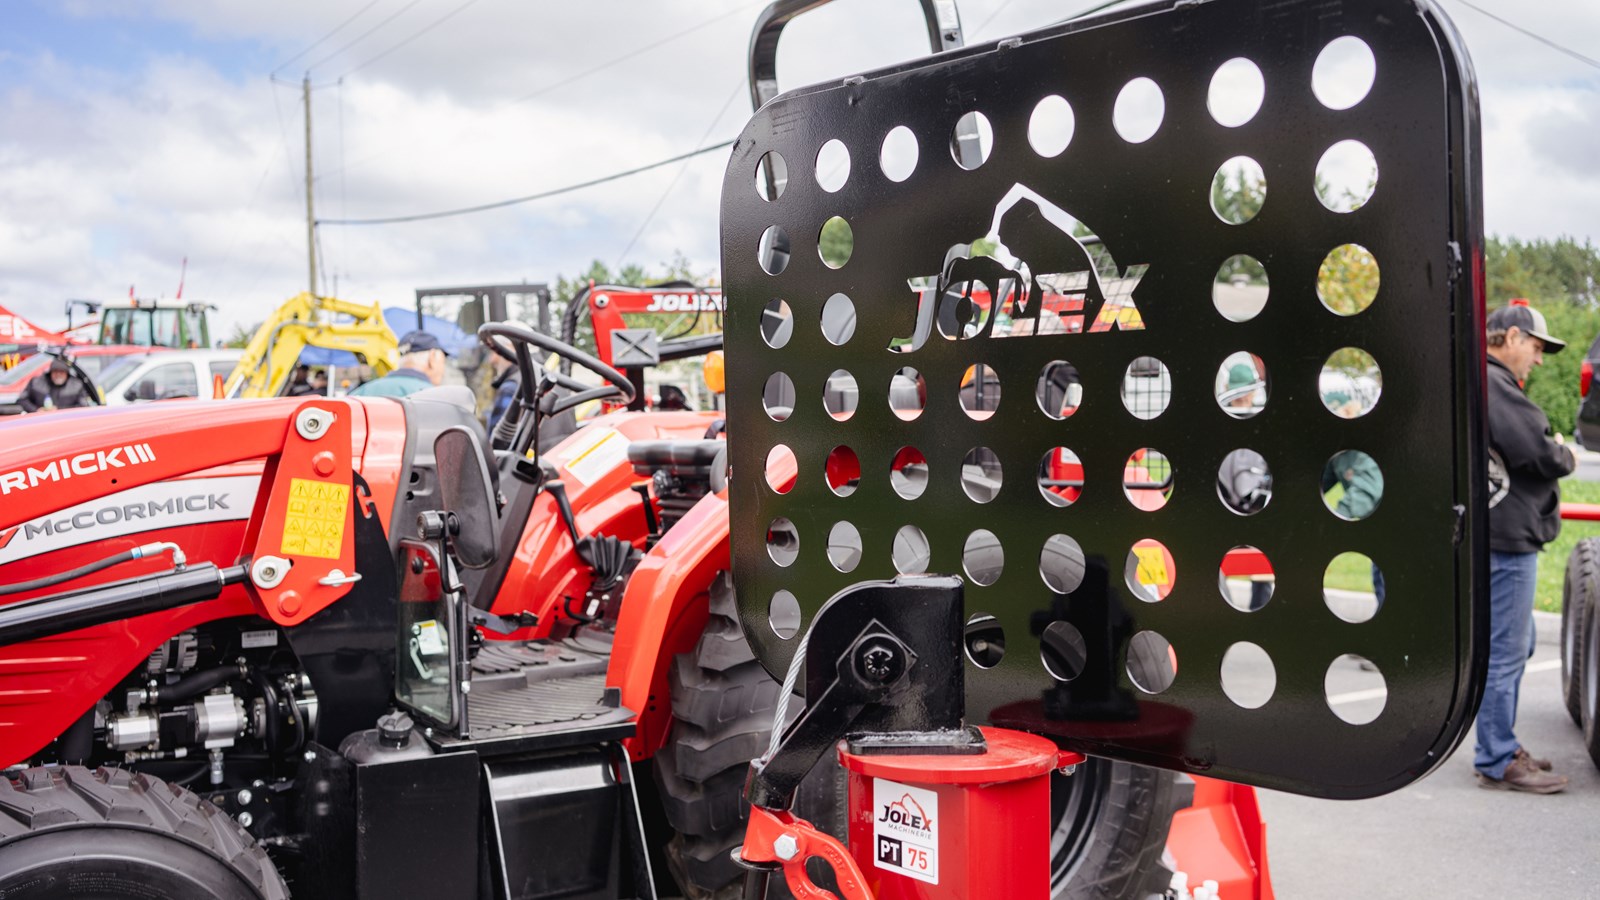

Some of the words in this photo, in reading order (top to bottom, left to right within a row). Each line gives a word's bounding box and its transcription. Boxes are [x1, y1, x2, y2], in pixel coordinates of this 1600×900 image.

[886, 264, 1150, 354] JOLEX
[24, 493, 230, 540] McCORMICK
[878, 804, 932, 832] JOLEX
[888, 823, 932, 840] MACHINERIE
[880, 840, 900, 862] PT
[908, 847, 928, 870] 75
